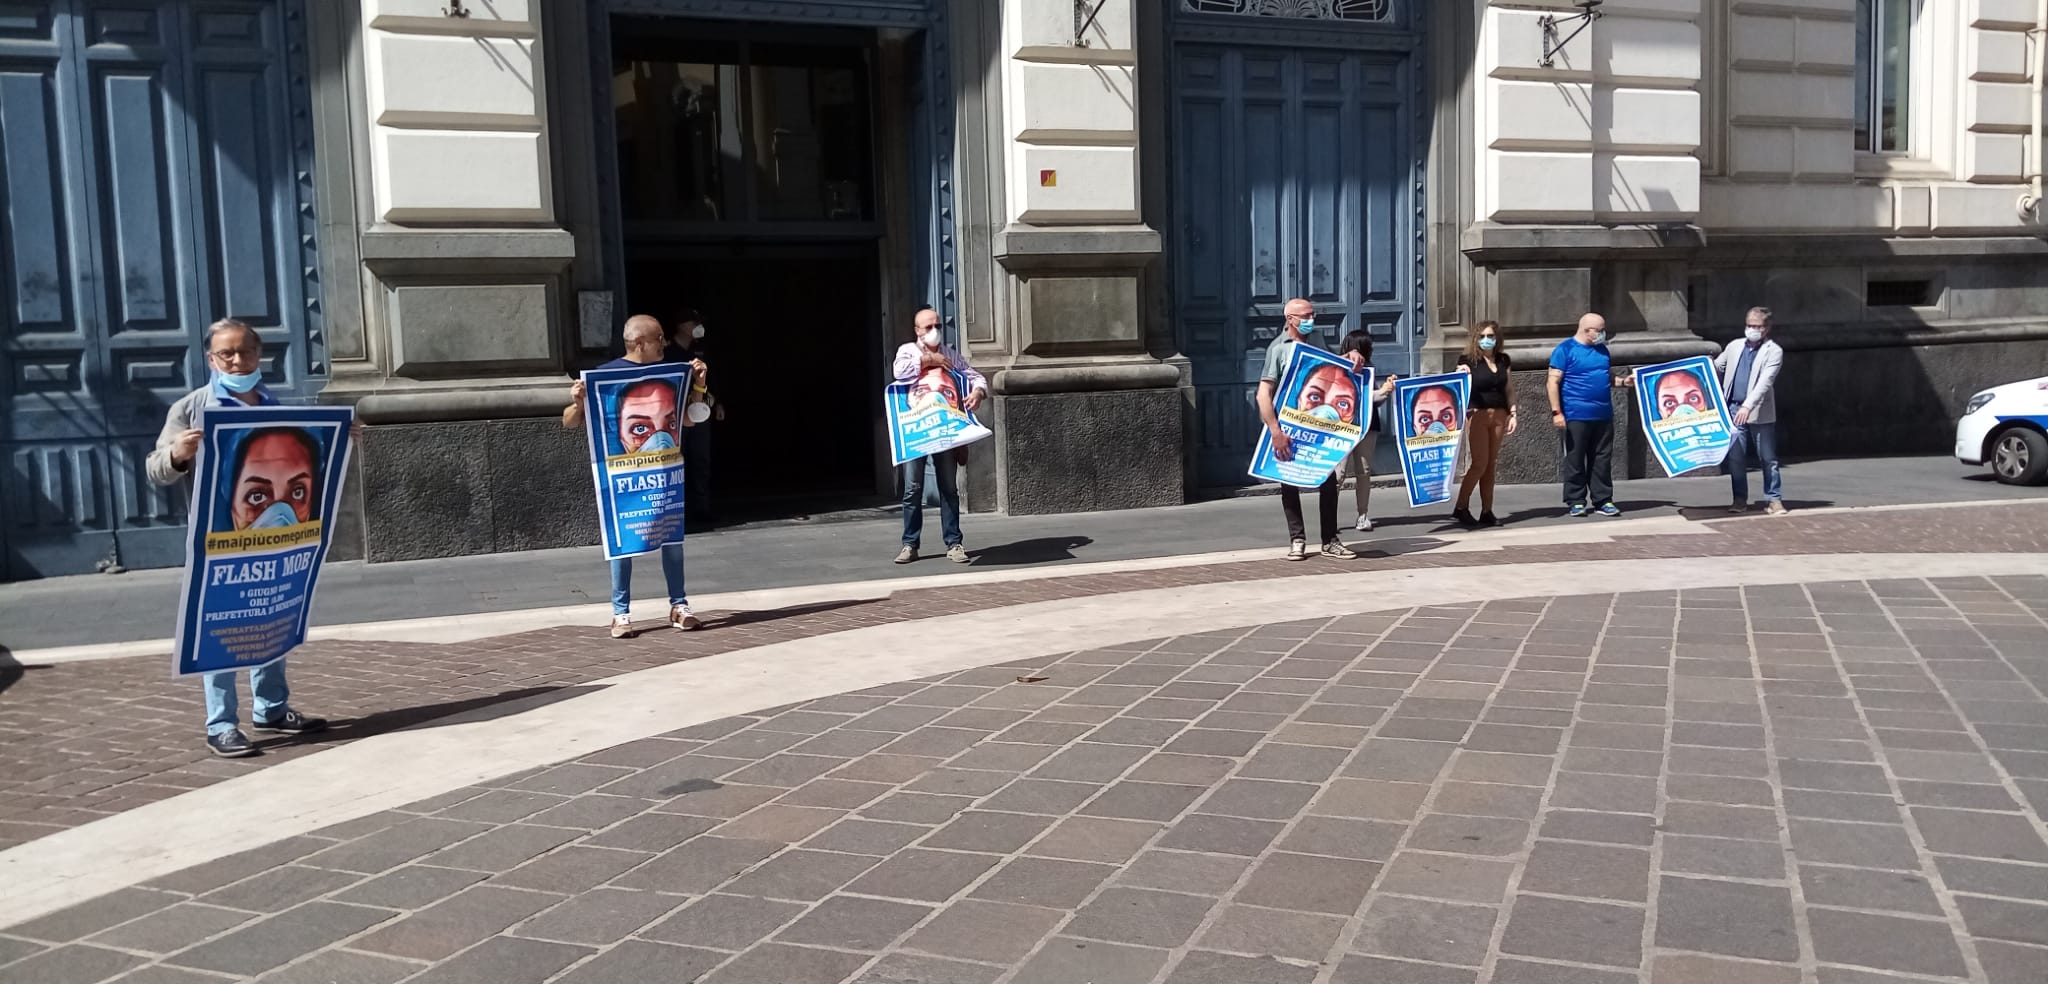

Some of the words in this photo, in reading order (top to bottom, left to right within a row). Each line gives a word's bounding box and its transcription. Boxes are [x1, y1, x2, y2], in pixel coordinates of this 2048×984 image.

[1442, 446, 1457, 459] MO
[616, 473, 667, 494] FLASH
[669, 468, 684, 486] MO
[208, 526, 320, 551] #maipiùcomeprima
[211, 560, 277, 586] FLASH
[282, 551, 312, 577] MOB
[249, 597, 270, 608] ORE
[205, 608, 267, 622] PREFETTURA
